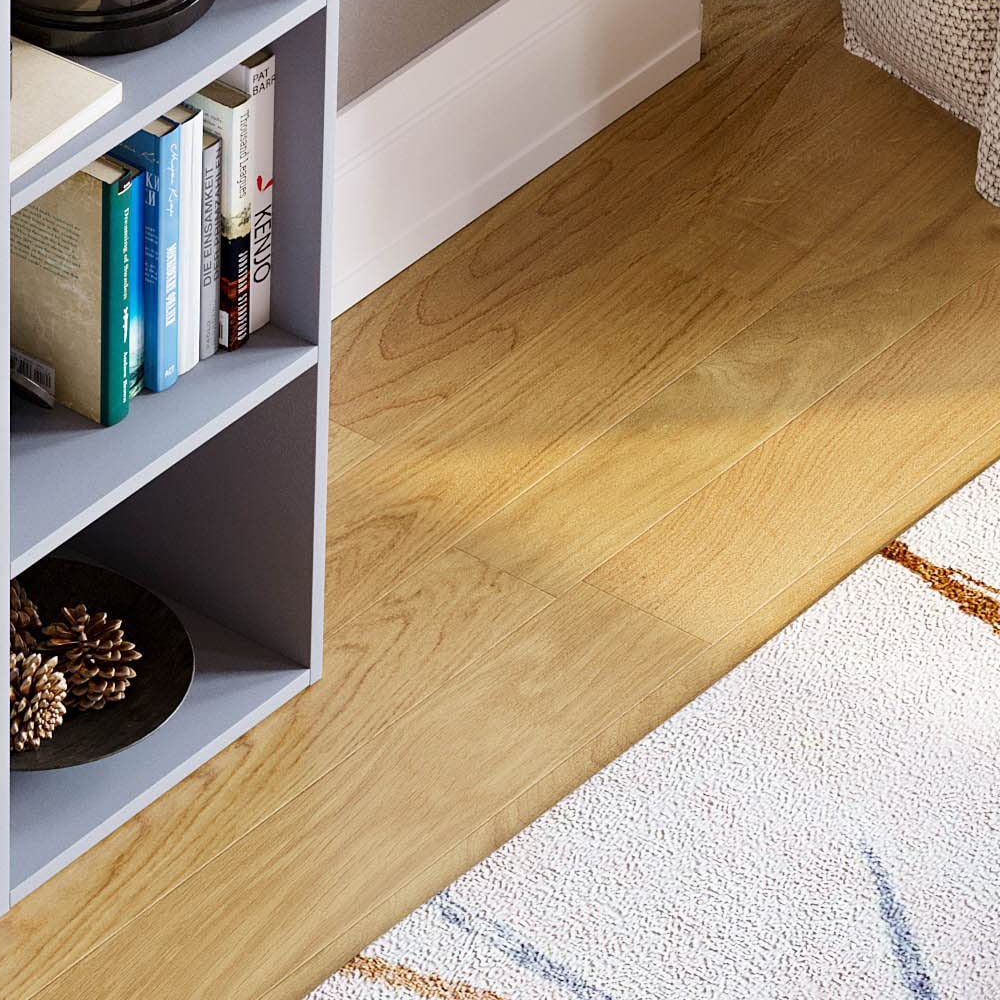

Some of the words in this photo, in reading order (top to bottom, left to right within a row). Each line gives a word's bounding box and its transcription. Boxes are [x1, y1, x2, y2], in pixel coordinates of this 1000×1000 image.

[252, 67, 270, 84] PAT
[240, 109, 250, 159] Thousand
[236, 159, 250, 199] Leagues
[203, 167, 214, 258] EINSAMKEIT
[203, 262, 212, 288] DIE
